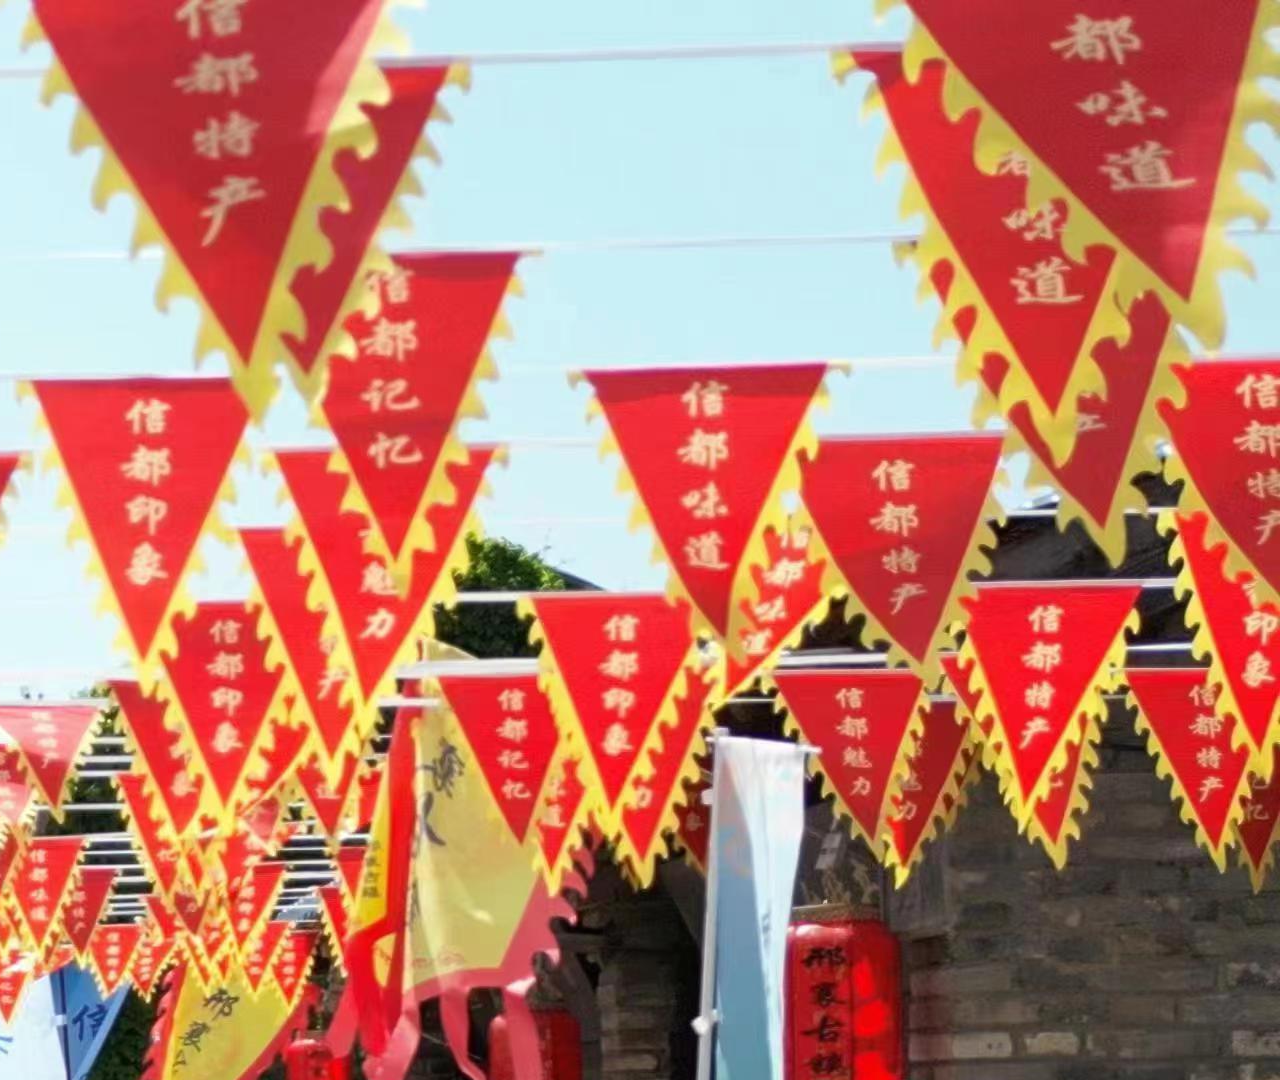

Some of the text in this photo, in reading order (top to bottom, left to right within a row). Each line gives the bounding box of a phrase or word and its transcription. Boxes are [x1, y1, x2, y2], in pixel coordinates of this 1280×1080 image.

[175, 0, 266, 248] 信都特产
[360, 266, 423, 468] 信都记忆
[120, 398, 171, 587] 信都印象
[677, 380, 730, 570] 信都味道
[869, 459, 927, 616] 信都特产
[206, 619, 245, 754] 信都印象
[495, 689, 532, 800] 信都记忆
[599, 613, 640, 757] 信都印象
[835, 686, 873, 797] 信都魅力
[1017, 605, 1065, 751] 信都特产
[1188, 683, 1228, 803] 信都特产
